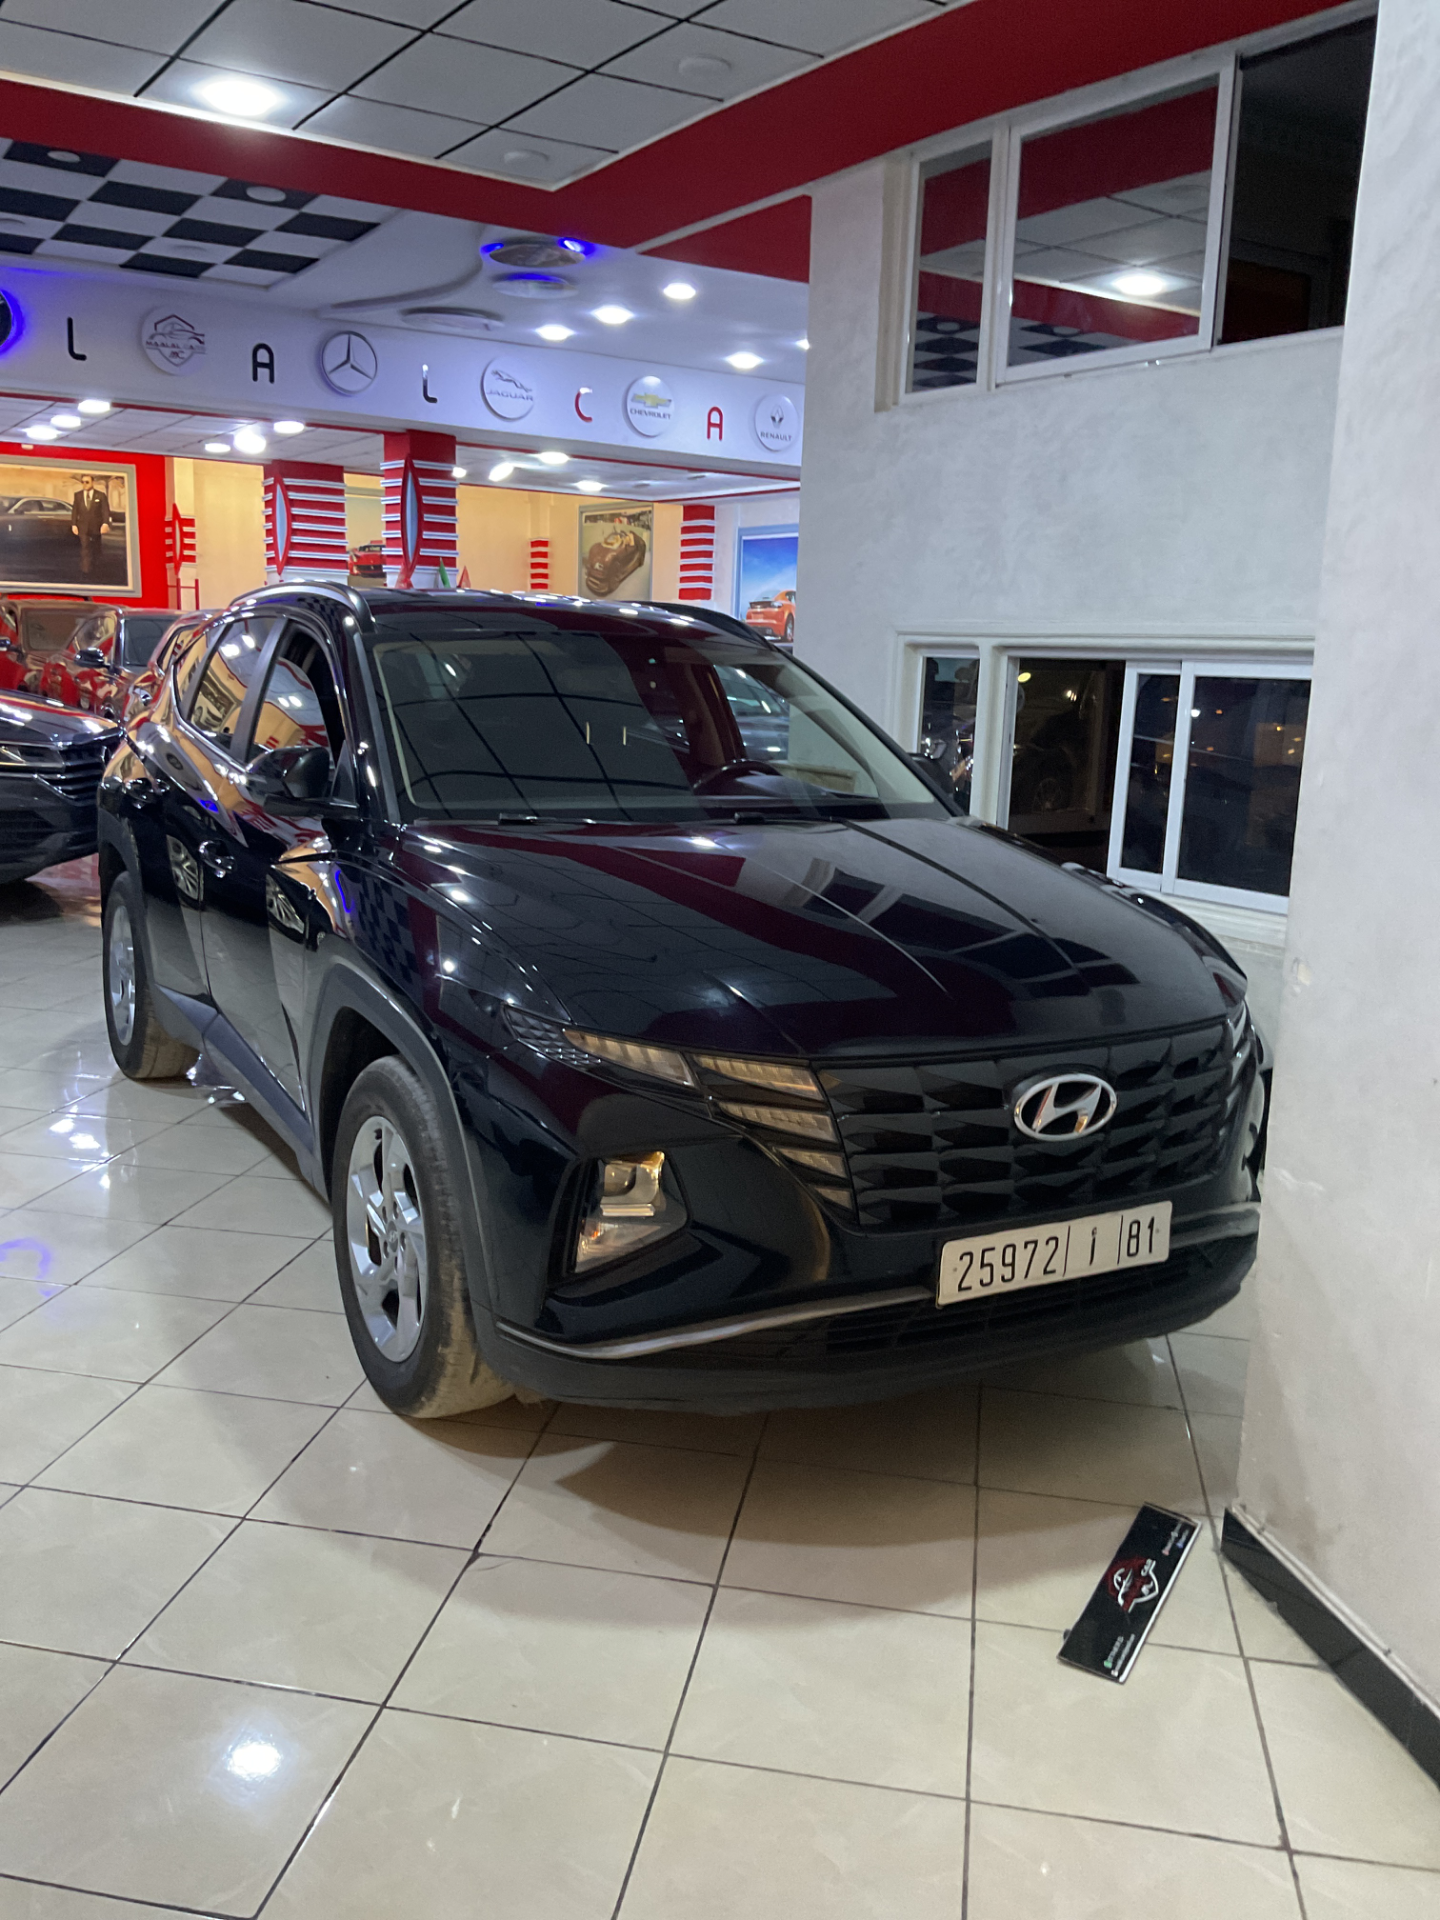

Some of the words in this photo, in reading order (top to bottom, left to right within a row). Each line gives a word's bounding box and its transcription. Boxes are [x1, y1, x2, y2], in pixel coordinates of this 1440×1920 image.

[67, 316, 87, 361] L
[252, 342, 275, 384] A
[706, 405, 724, 441] A
[486, 388, 534, 402] JAGUAR
[629, 407, 672, 420] CHEVROLET
[759, 430, 792, 442] RENAULT
[957, 1236, 1060, 1293] 25972
[1126, 1216, 1156, 1258] 81
